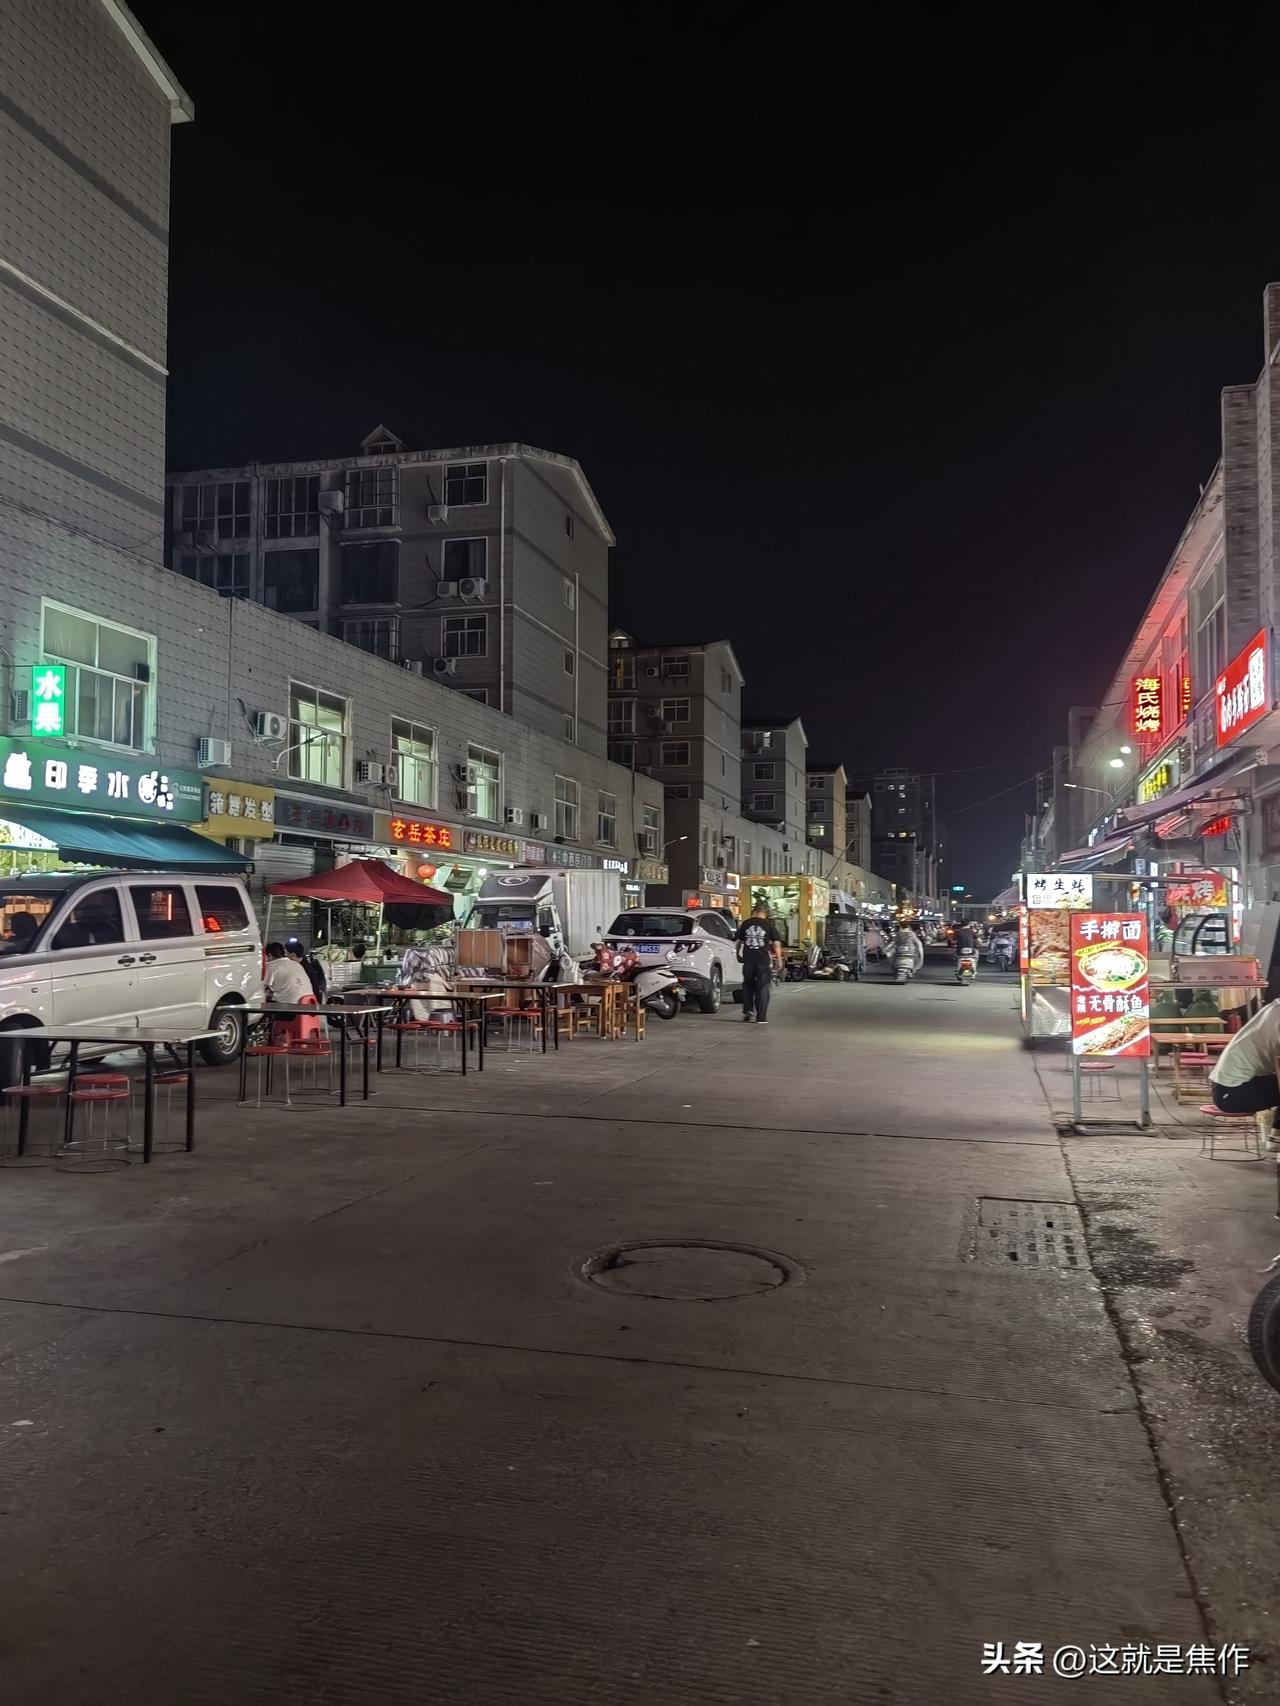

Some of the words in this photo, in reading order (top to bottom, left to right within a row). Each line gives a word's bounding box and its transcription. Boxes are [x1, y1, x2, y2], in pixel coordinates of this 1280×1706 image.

[35, 670, 63, 732] 水果
[391, 819, 452, 848] 玄岳茶庄
[1034, 878, 1085, 894] 烤生蚝
[1080, 919, 1142, 941] 手擀面
[1089, 995, 1144, 1014] 无骨酥鱼
